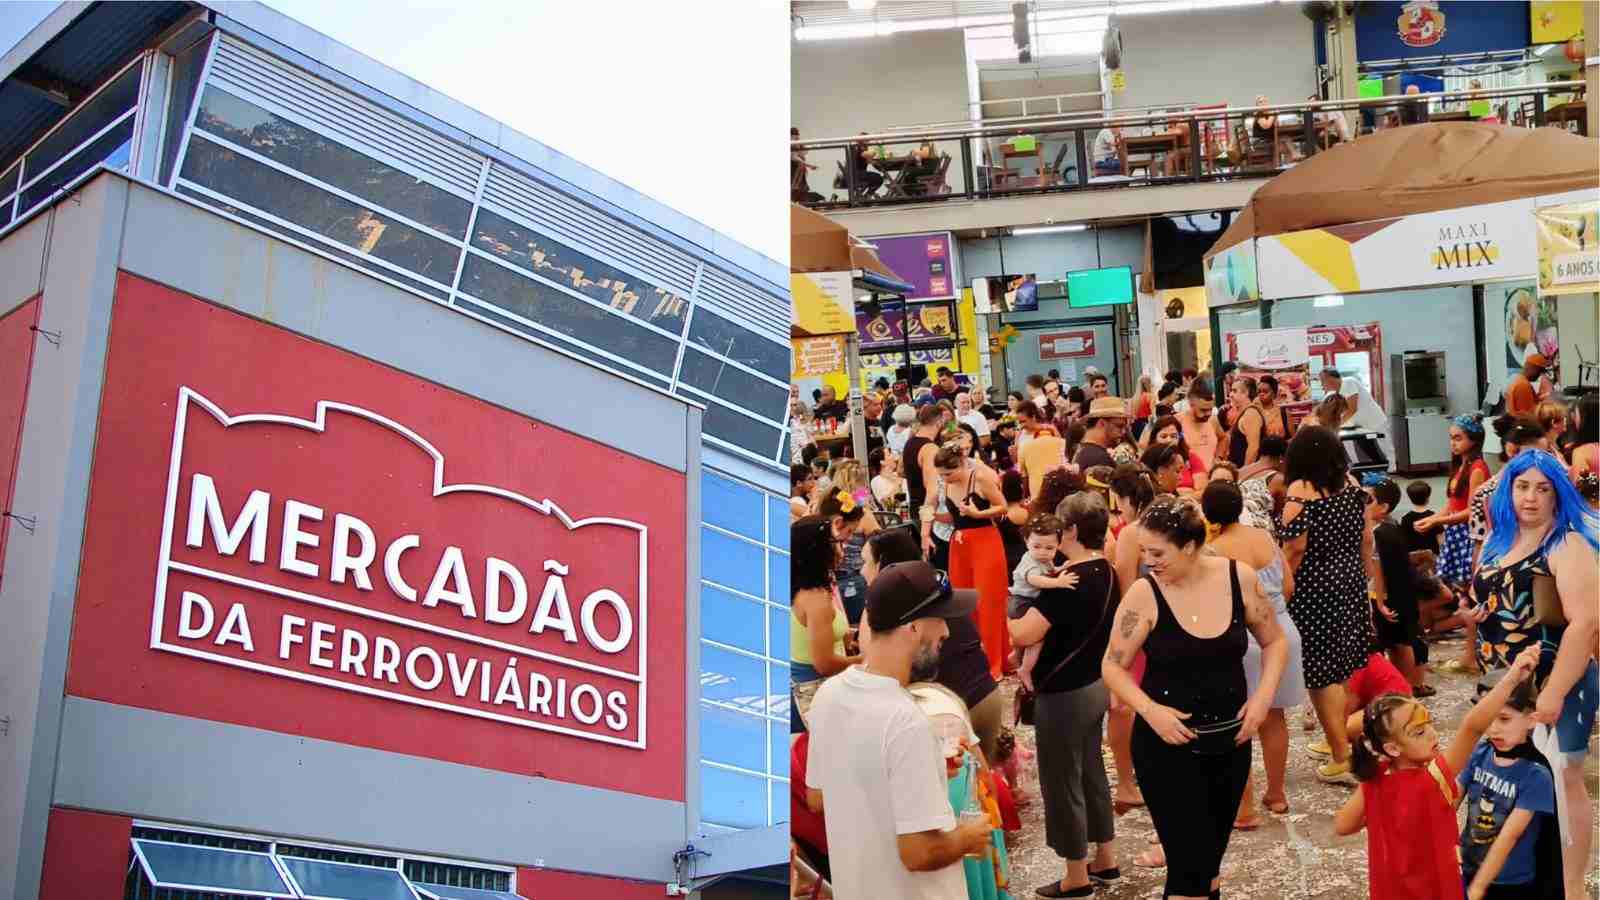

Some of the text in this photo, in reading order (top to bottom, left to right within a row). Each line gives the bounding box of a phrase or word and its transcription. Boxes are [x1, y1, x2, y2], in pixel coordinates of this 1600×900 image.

[1439, 222, 1488, 241] MAXI
[1436, 240, 1494, 270] MIX
[1567, 261, 1594, 278] ANOS
[1307, 334, 1329, 344] NES
[186, 472, 633, 654] MERCADÃO
[178, 591, 629, 731] DA FERROVIÁRIOS
